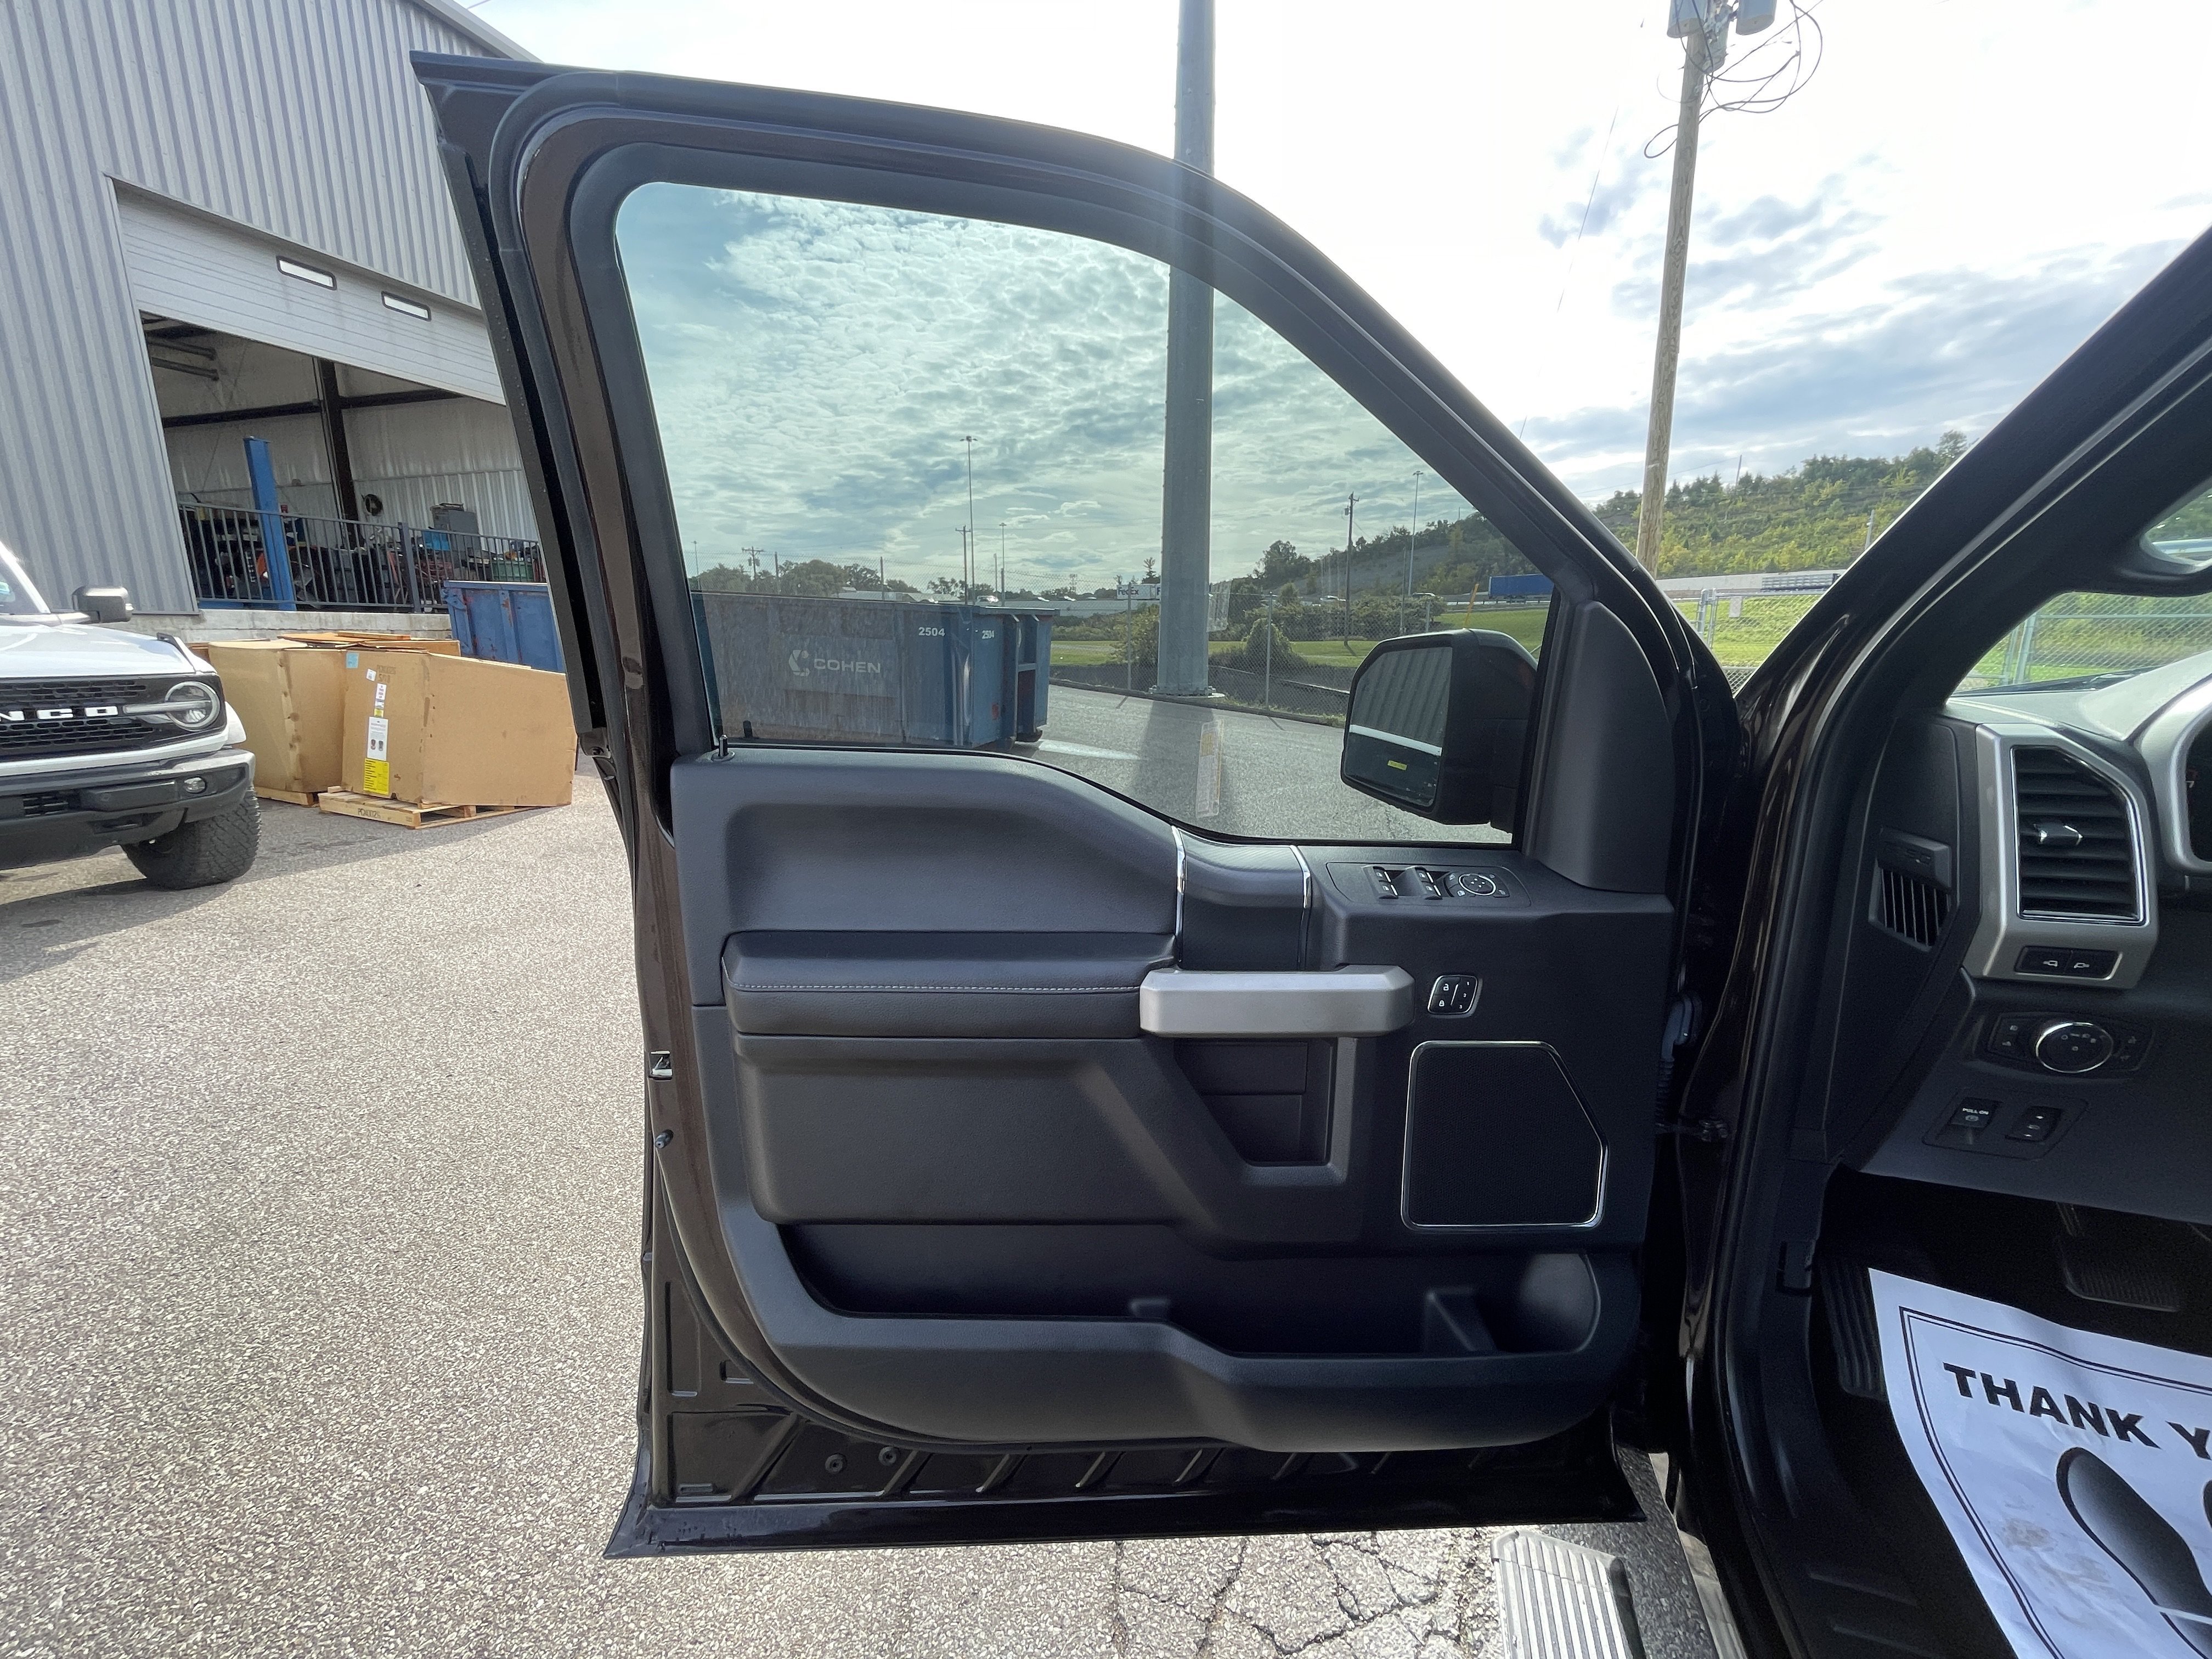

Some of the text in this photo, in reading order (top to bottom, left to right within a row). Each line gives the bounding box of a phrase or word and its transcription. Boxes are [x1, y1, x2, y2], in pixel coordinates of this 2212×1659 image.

[918, 627, 945, 637] 2504
[814, 658, 881, 674] COHEN
[1943, 1363, 2160, 1449] THANK
